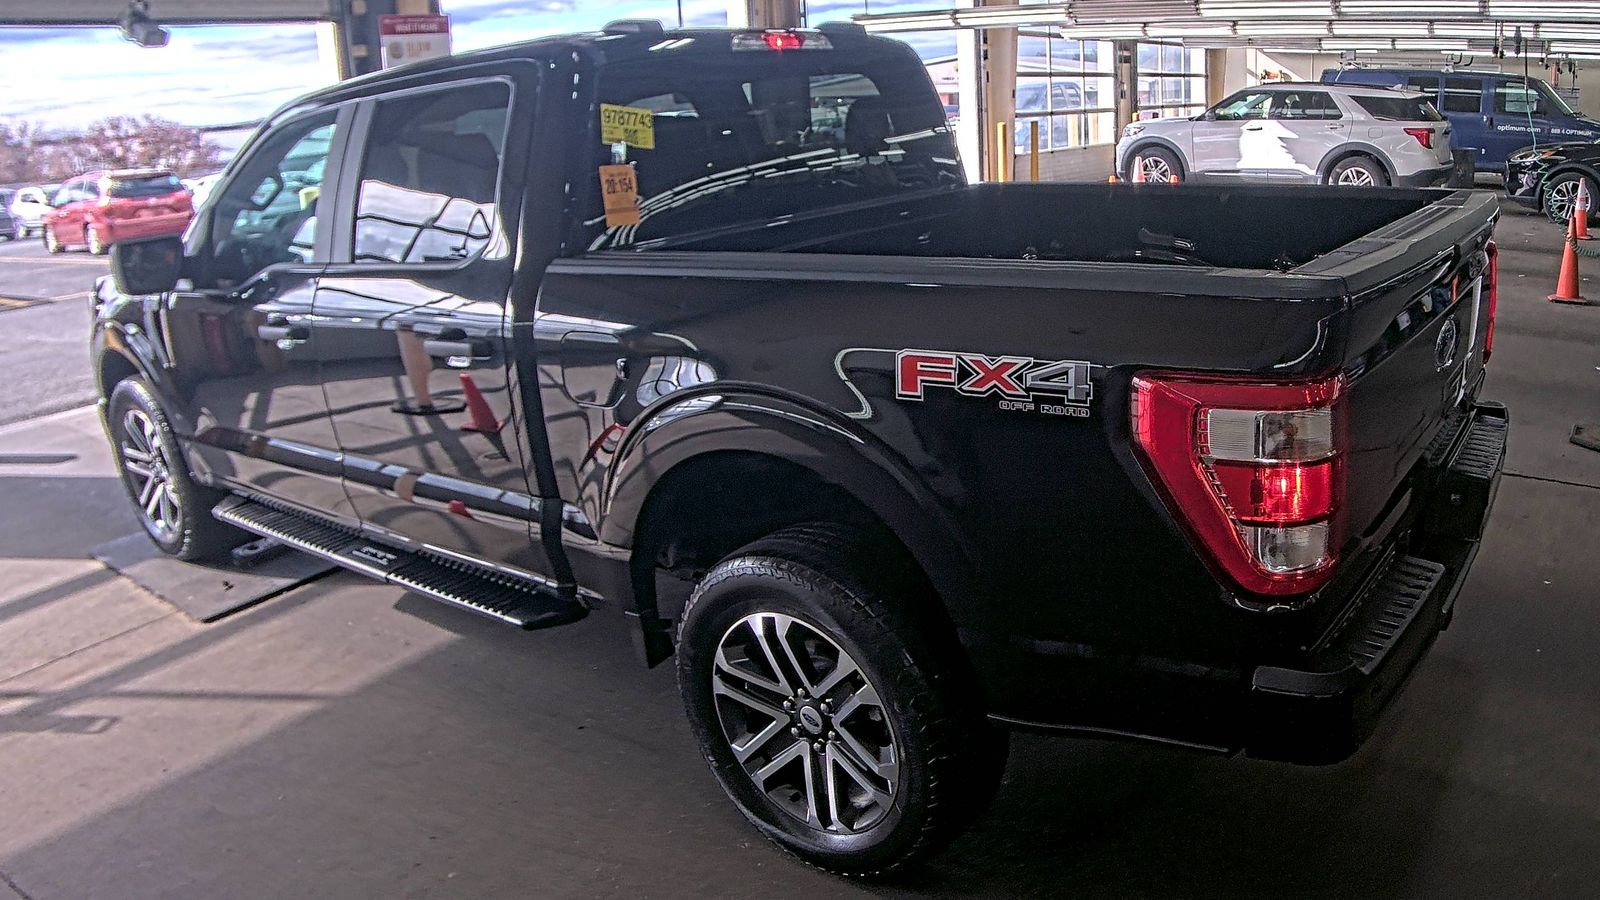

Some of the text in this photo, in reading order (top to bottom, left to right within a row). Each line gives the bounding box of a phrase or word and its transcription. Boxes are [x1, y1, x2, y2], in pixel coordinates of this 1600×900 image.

[603, 108, 652, 129] 9787743
[1565, 128, 1592, 136] OPTIMUM
[896, 348, 1093, 407] FX4
[999, 400, 1090, 418] OFF ROAD
